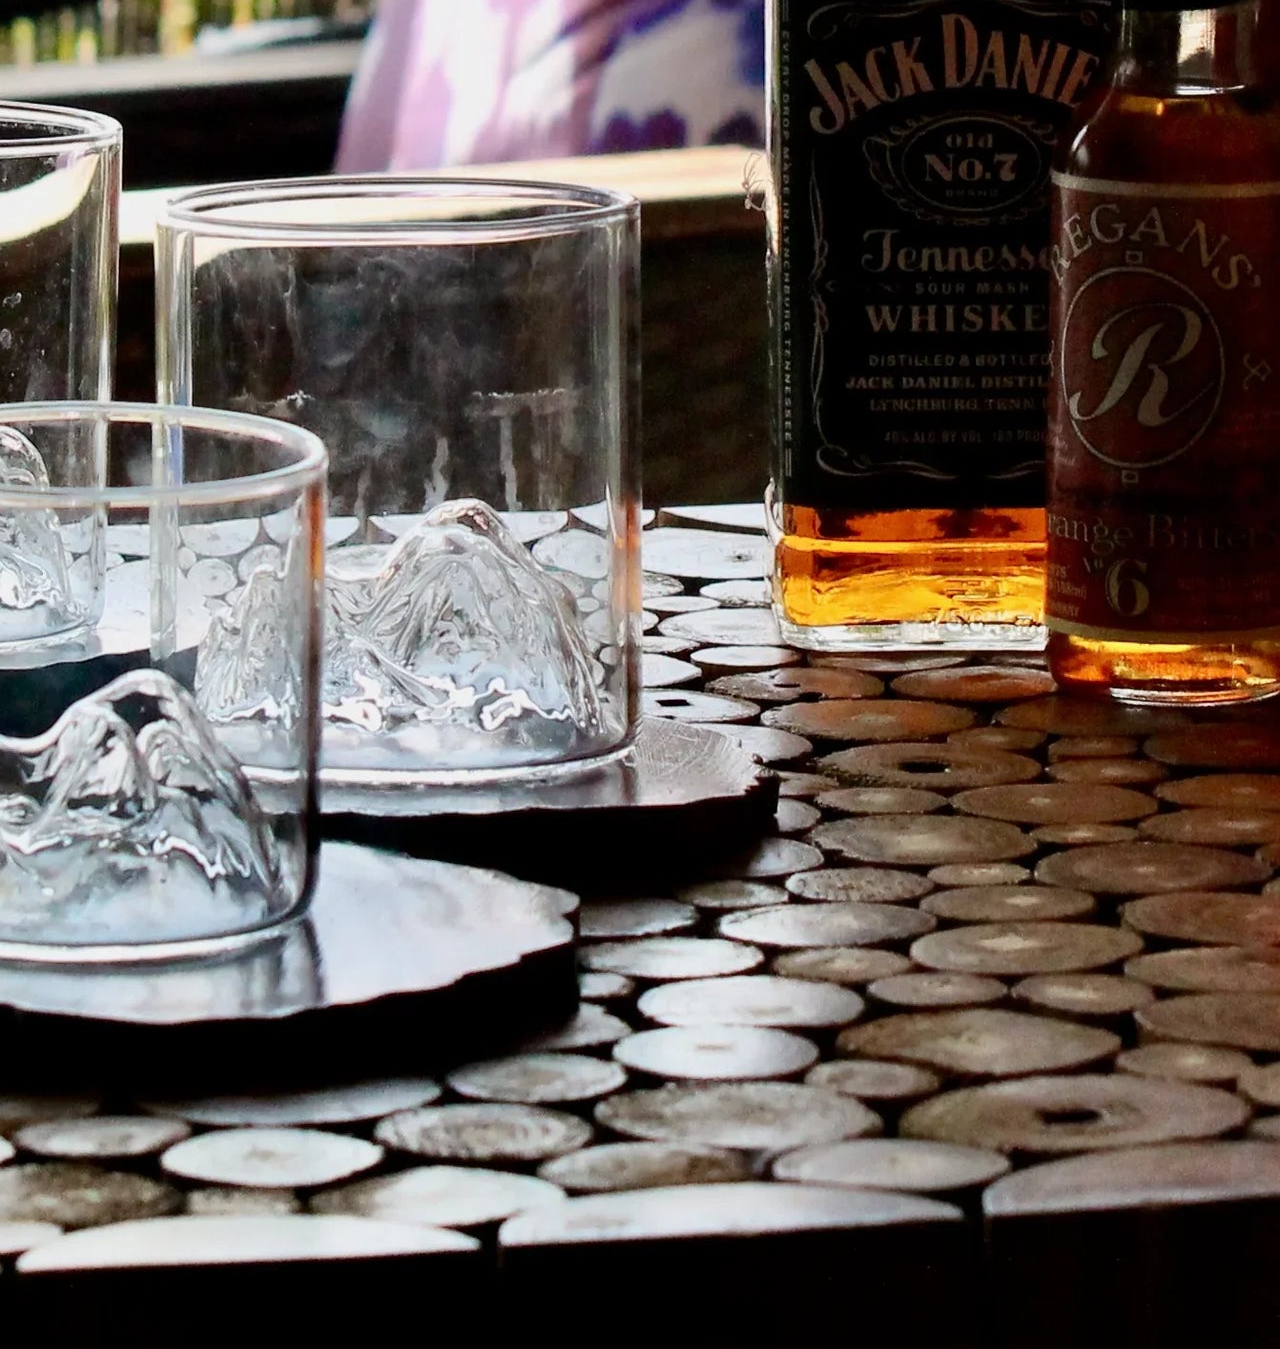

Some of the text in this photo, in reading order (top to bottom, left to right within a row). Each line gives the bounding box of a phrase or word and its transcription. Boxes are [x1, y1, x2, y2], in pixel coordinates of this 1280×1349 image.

[804, 12, 1101, 136] JACK DANIE
[782, 93, 791, 142] DROP
[914, 281, 1030, 296] SOUR MASH
[864, 303, 1049, 334] WHISKE
[868, 353, 956, 368] DISTILLED
[1068, 301, 1217, 429] R
[845, 375, 1049, 390] JACK DANIEL DISTIL
[1047, 512, 1134, 555] range
[1104, 557, 1151, 618] 6
